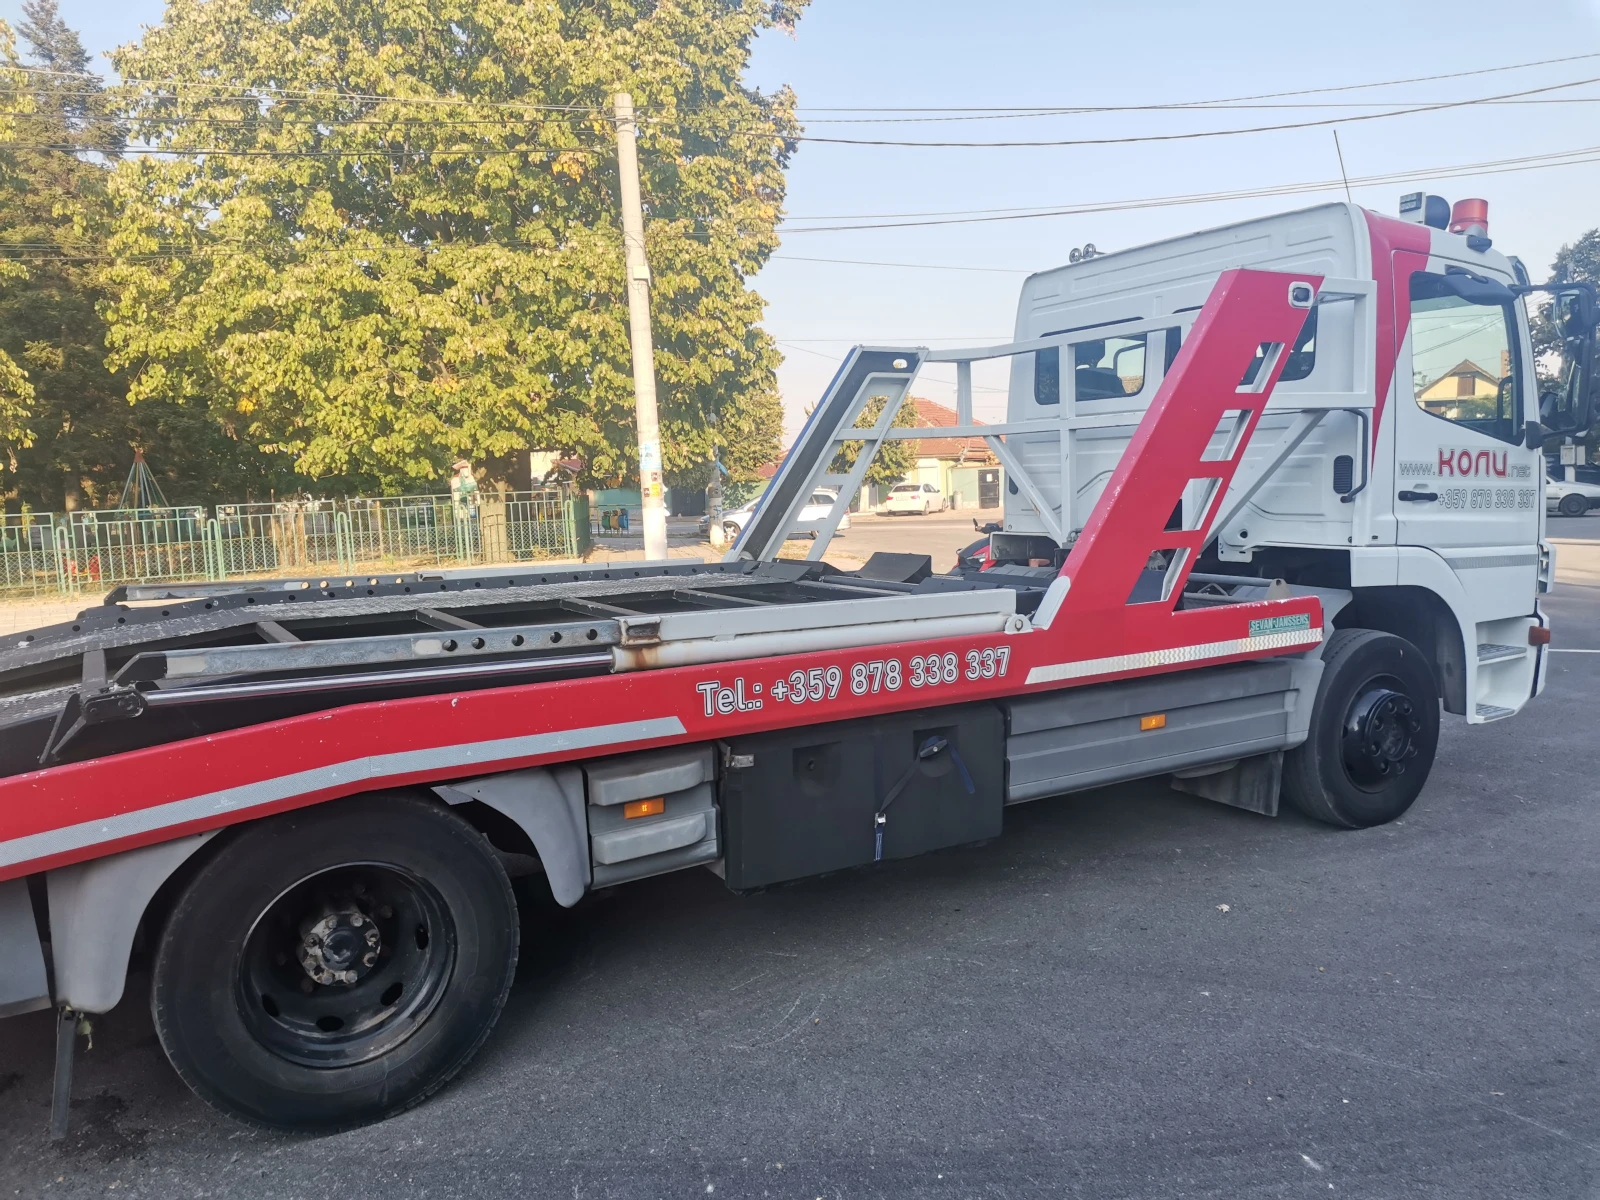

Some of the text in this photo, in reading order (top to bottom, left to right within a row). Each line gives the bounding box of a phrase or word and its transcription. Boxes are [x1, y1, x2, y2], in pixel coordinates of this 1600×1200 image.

[1438, 489, 1537, 509] +359 878 338 337
[696, 645, 1011, 717] Tel.: +359 878 338 337
